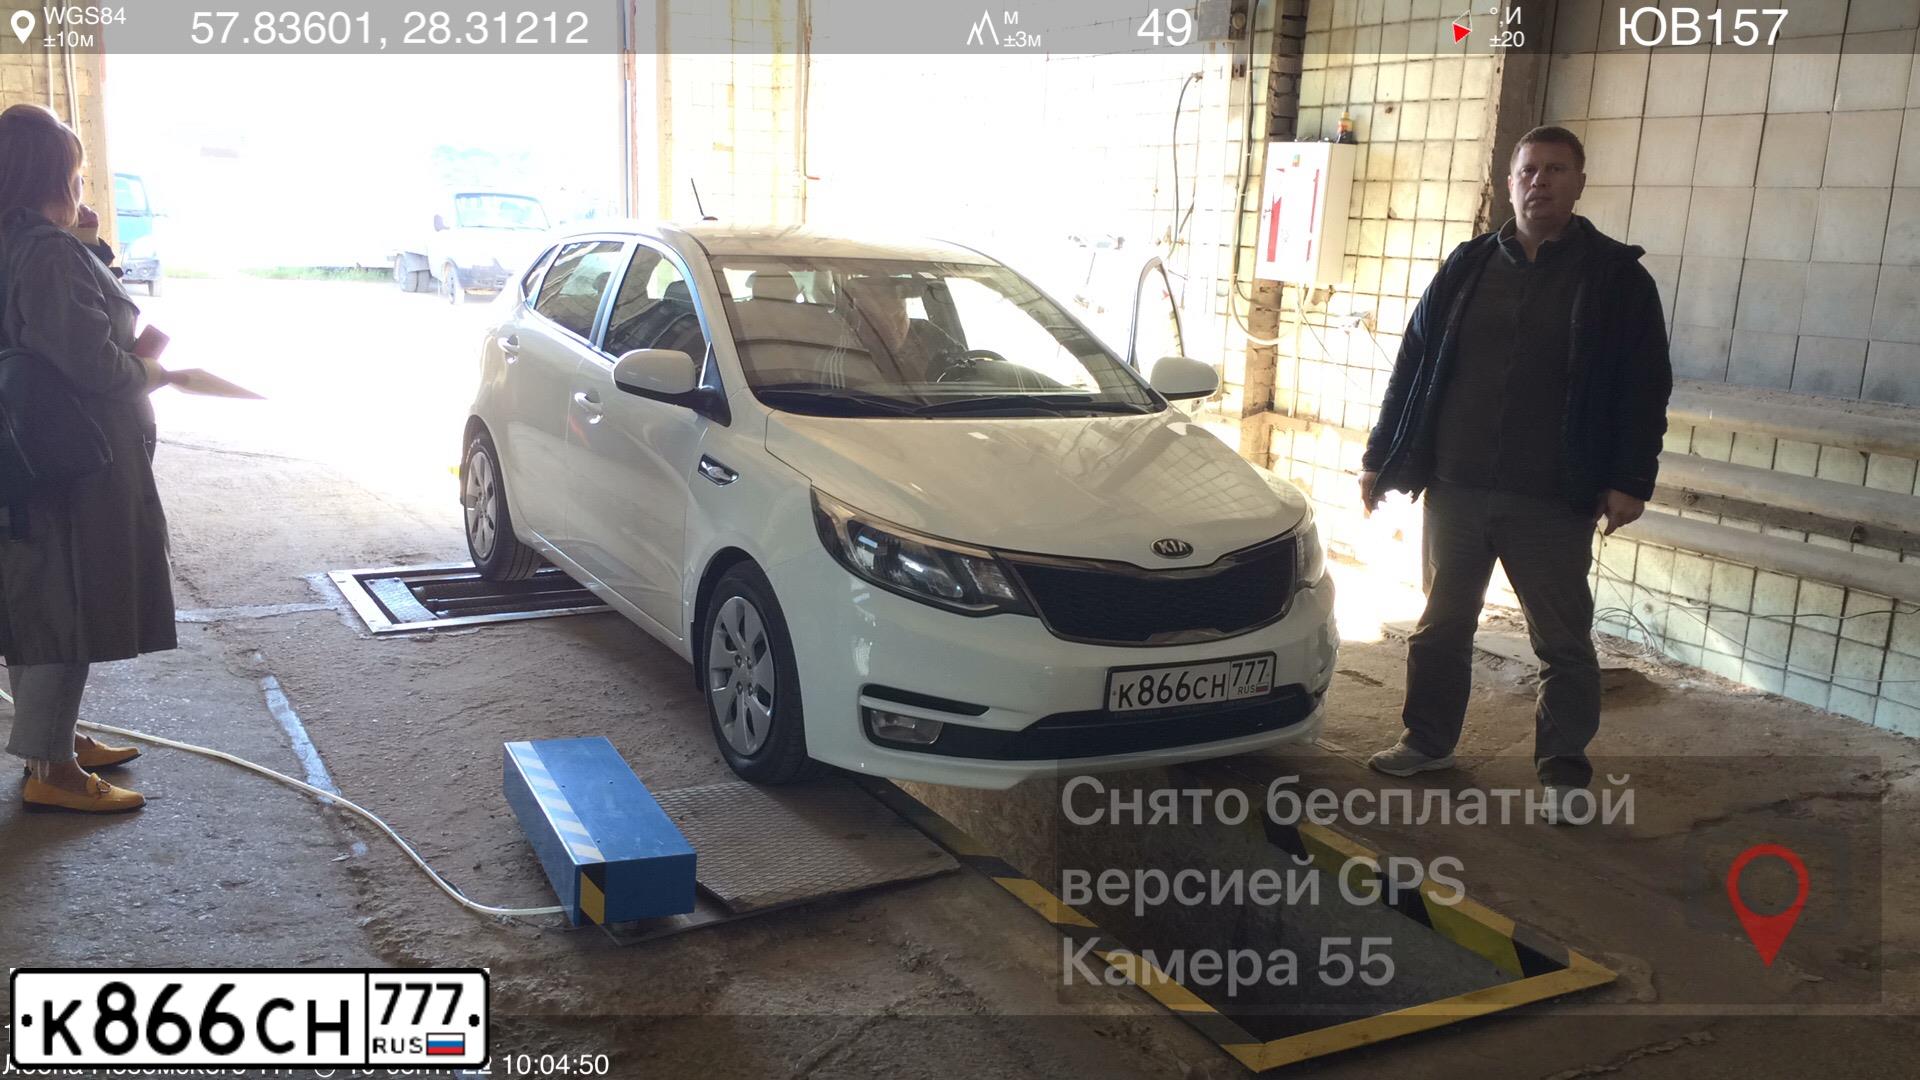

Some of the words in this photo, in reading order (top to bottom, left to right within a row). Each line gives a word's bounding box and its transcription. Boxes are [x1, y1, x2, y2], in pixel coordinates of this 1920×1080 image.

[1157, 540, 1189, 553] KIA
[1232, 659, 1269, 687] 777
[1237, 685, 1256, 694] RUS
